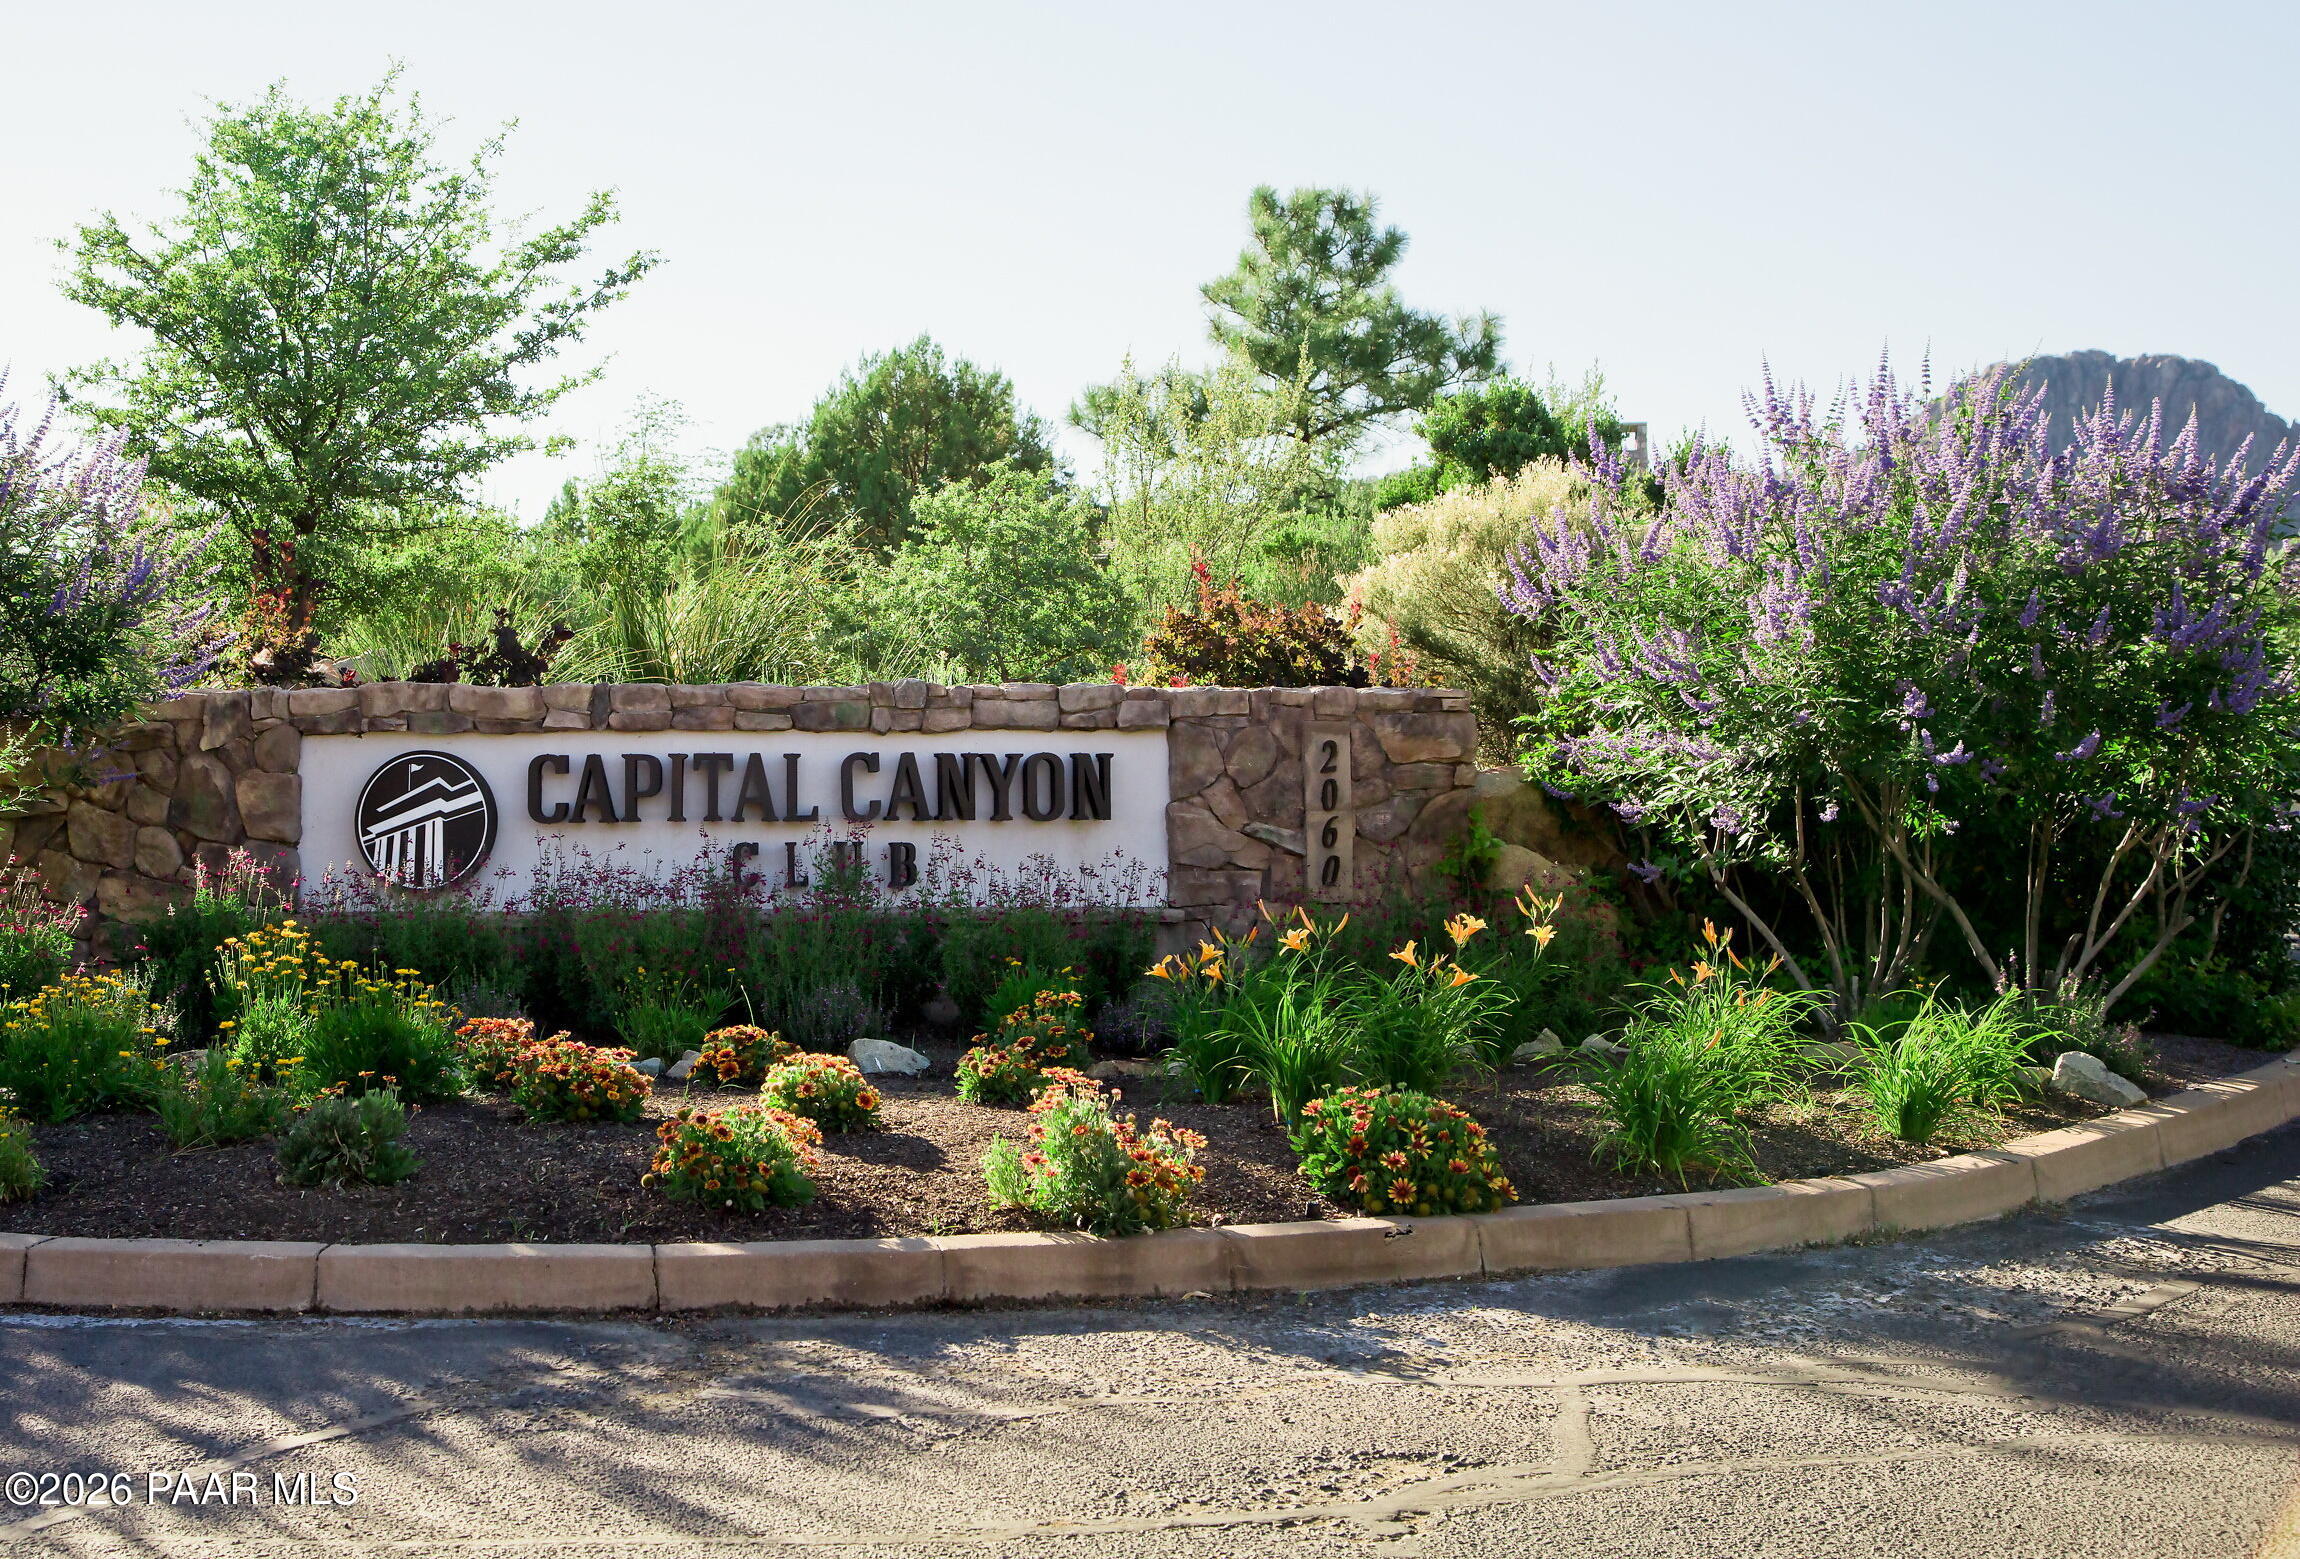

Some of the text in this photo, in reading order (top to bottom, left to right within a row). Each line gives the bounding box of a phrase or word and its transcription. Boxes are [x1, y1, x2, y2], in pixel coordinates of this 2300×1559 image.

[527, 751, 1114, 824] CAPITAL CANYON
[1319, 739, 1340, 887] 2060
